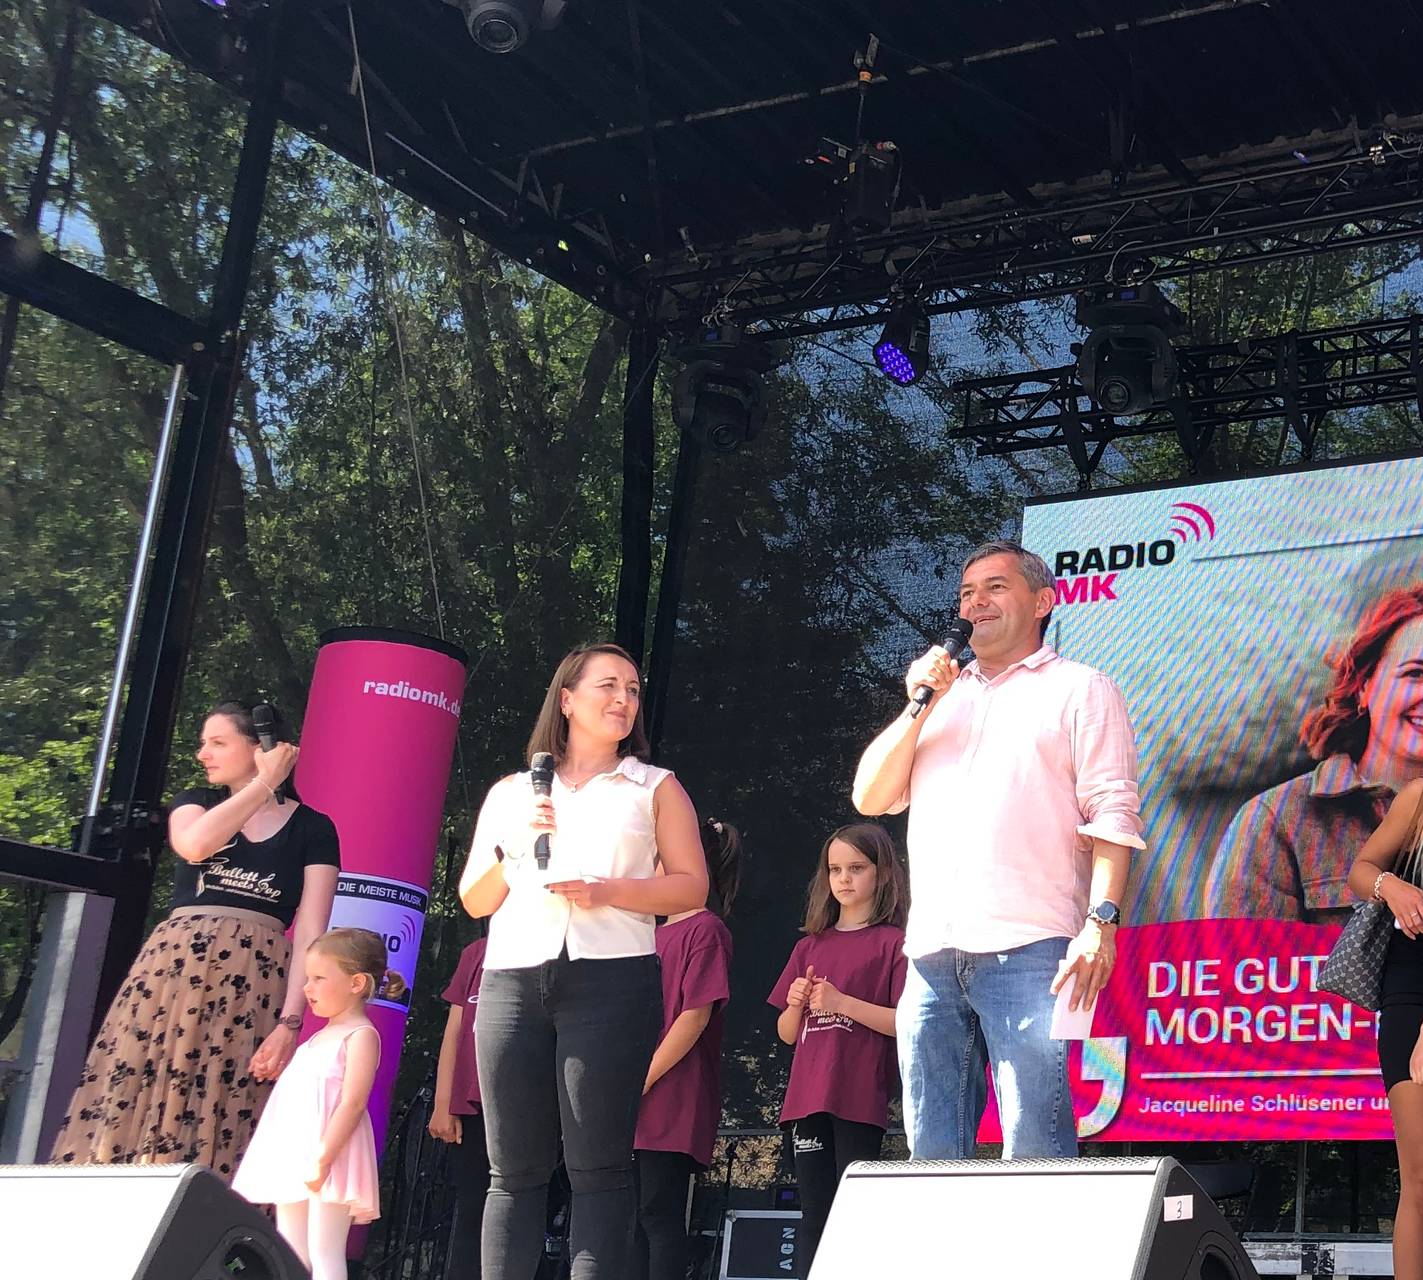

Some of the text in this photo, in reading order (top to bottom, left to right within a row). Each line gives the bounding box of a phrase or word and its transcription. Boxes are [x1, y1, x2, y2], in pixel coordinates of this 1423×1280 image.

[1055, 539, 1176, 577] RADIO
[1055, 573, 1118, 606] MK
[208, 864, 259, 881] Ballett
[221, 878, 253, 890] meets
[253, 873, 281, 898] Pop
[337, 881, 356, 893] DIE
[358, 884, 398, 899] MEISTE
[1147, 954, 1331, 998] DIE GUT
[1139, 1095, 1245, 1117] Jacqueline
[1251, 1094, 1365, 1112] Schlüsener
[1176, 1200, 1183, 1219] 3
